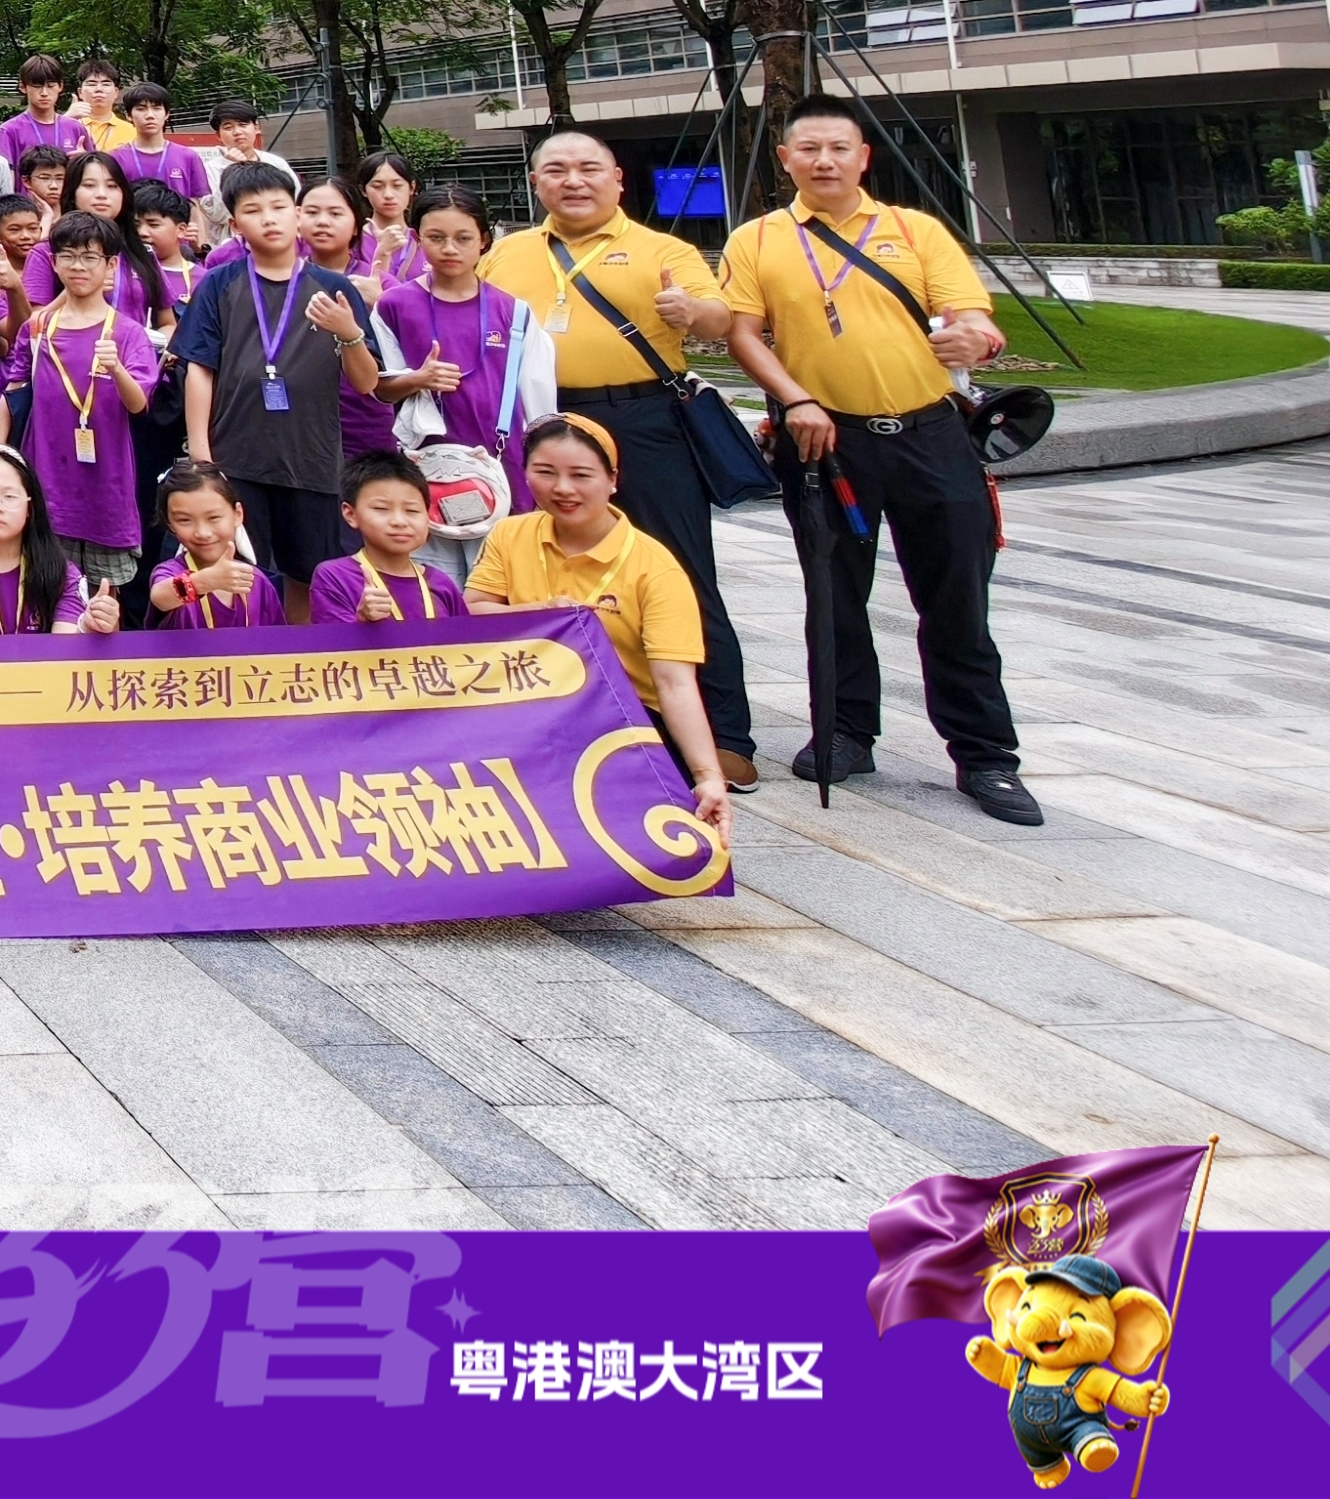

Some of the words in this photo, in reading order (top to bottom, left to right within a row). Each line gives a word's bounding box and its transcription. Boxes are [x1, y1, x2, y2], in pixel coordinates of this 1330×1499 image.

[65, 652, 552, 713] 从探索到立志的卓越之旅
